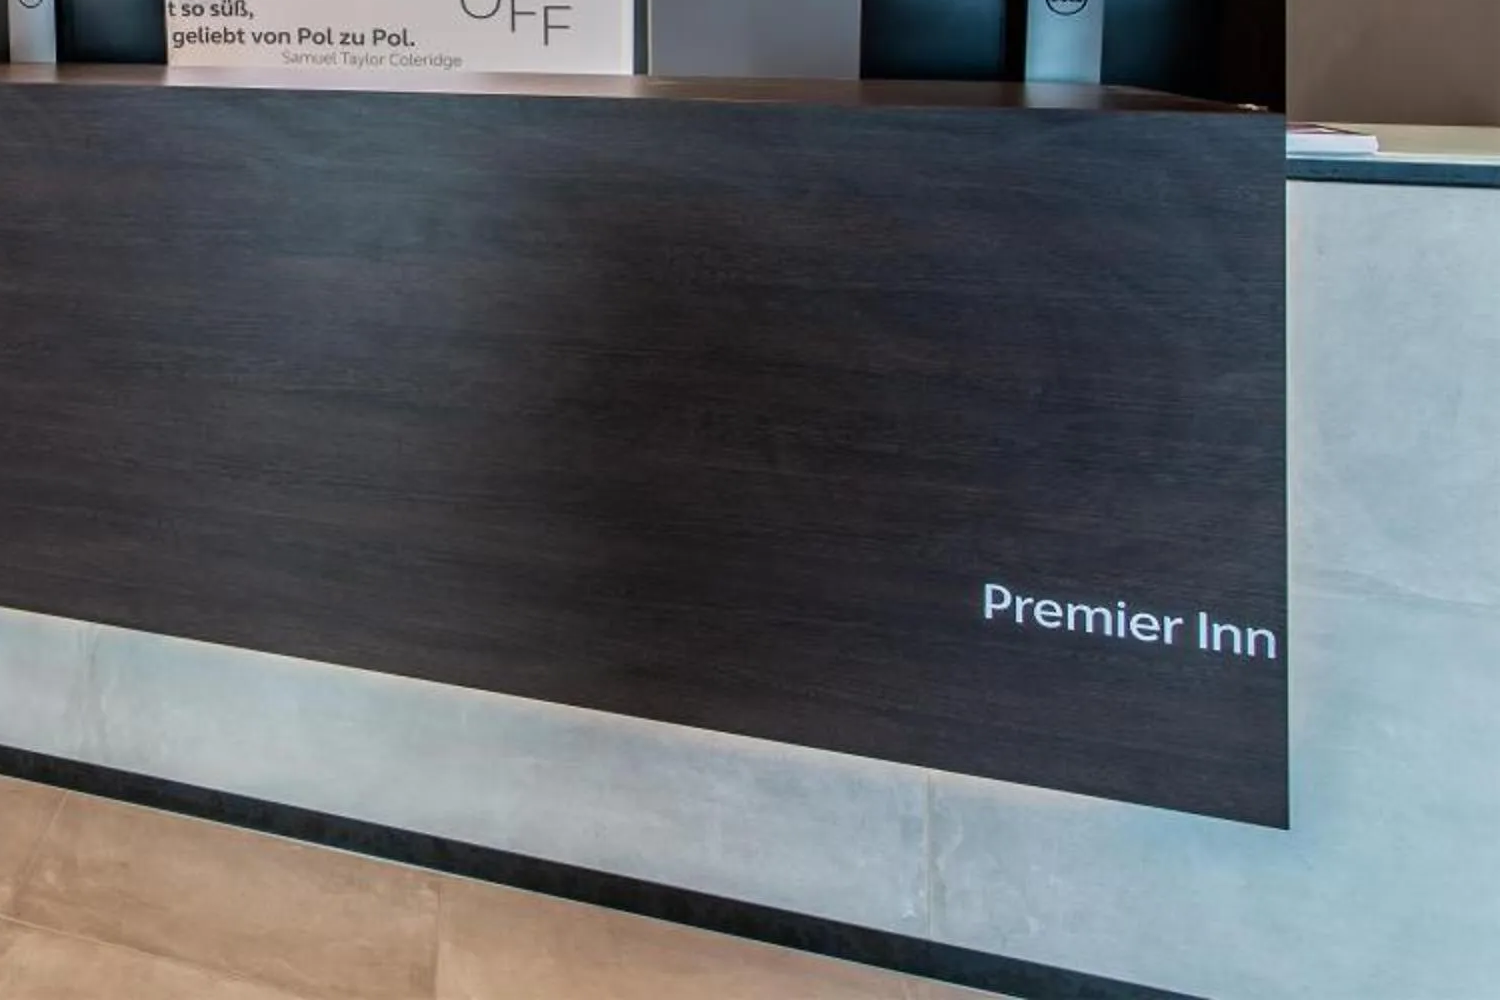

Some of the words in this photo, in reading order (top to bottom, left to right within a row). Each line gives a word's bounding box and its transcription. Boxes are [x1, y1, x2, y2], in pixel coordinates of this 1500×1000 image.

[181, 1, 205, 17] so
[210, 0, 255, 20] süß,
[171, 25, 246, 49] geliebt
[251, 30, 291, 46] von
[298, 27, 333, 47] Pol
[339, 31, 365, 46] zu
[372, 28, 416, 47] Pol.
[281, 50, 338, 65] Samuel
[341, 51, 386, 68] Taylor
[389, 53, 463, 71] Coleridge
[983, 583, 1184, 646] Premier
[1199, 611, 1277, 660] Inn
